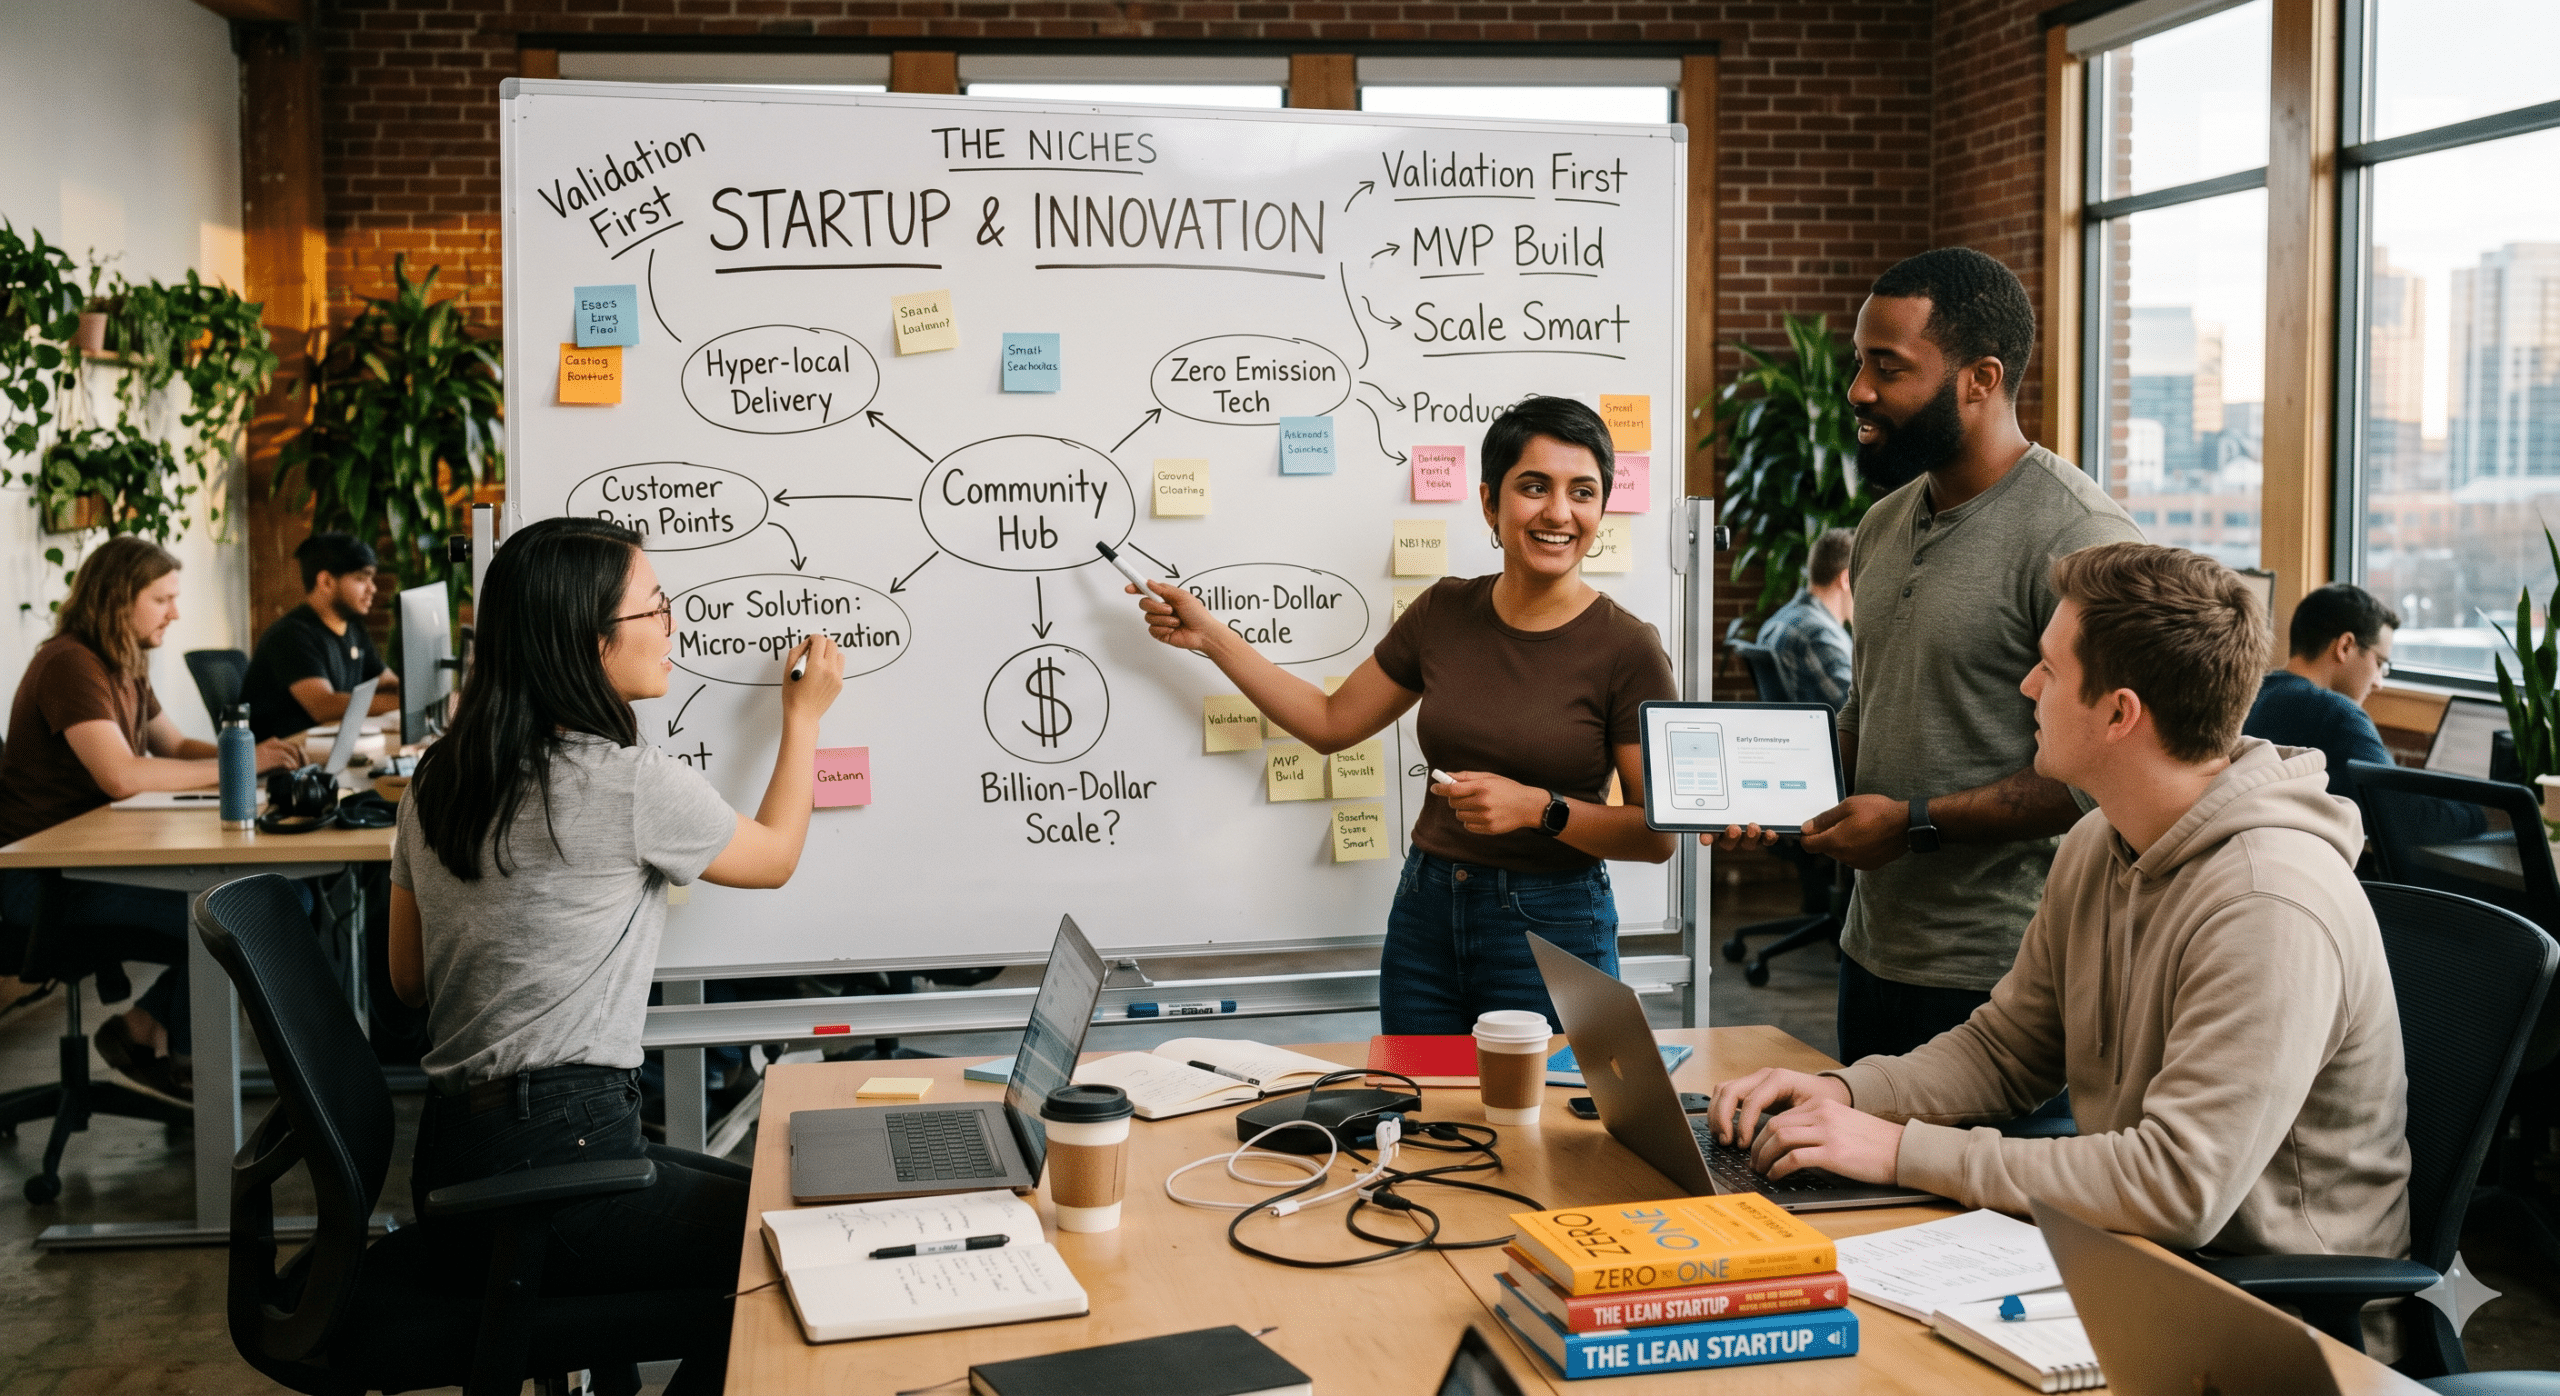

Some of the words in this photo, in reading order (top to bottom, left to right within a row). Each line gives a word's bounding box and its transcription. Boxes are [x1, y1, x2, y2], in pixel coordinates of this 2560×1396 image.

[930, 126, 1006, 160] THE
[1029, 129, 1157, 164] NICHES
[537, 129, 706, 220] Validation
[1381, 149, 1534, 190] Validation
[1552, 151, 1629, 194] First
[589, 185, 673, 248] First
[709, 186, 951, 252] STARTUP
[976, 195, 1006, 248] &
[1034, 192, 1325, 255] INNOVATION
[1413, 223, 1494, 268] MVP
[1514, 224, 1605, 269] Build
[1413, 301, 1507, 343] Scale
[1523, 300, 1631, 344] Smart
[706, 344, 850, 386] Hyper-local
[1170, 357, 1227, 383] Zero
[1236, 355, 1336, 382] Emission
[730, 385, 833, 424] Delivery
[1212, 389, 1270, 414] Tech
[601, 475, 724, 503] Customer
[942, 467, 1108, 520] Community
[658, 506, 735, 536] Points
[998, 514, 1059, 552] Hub
[685, 594, 735, 623] Our
[746, 587, 861, 619] Solution:
[1189, 584, 1343, 611] Billion-Dollar
[1227, 617, 1293, 644] Scale
[1207, 713, 1258, 725] Validation
[1736, 735, 1752, 744] Early
[1272, 755, 1300, 768] MVP
[1275, 769, 1304, 782] Build
[980, 769, 1158, 804] Billion-Dollar
[1025, 809, 1121, 846] Scale?
[1343, 836, 1375, 850] Smart
[1552, 1212, 1632, 1259] ZERO
[1620, 1208, 1700, 1251] ONE
[1594, 1265, 1656, 1290] ZERO
[1677, 1258, 1731, 1283] ONE
[1593, 1306, 1621, 1326] THE
[1625, 1301, 1663, 1322] LEAN
[1666, 1296, 1730, 1318] STARTUP
[1583, 1344, 1629, 1369] THE
[1637, 1338, 1700, 1365] LEAN
[1706, 1328, 1814, 1359] STARTUP
